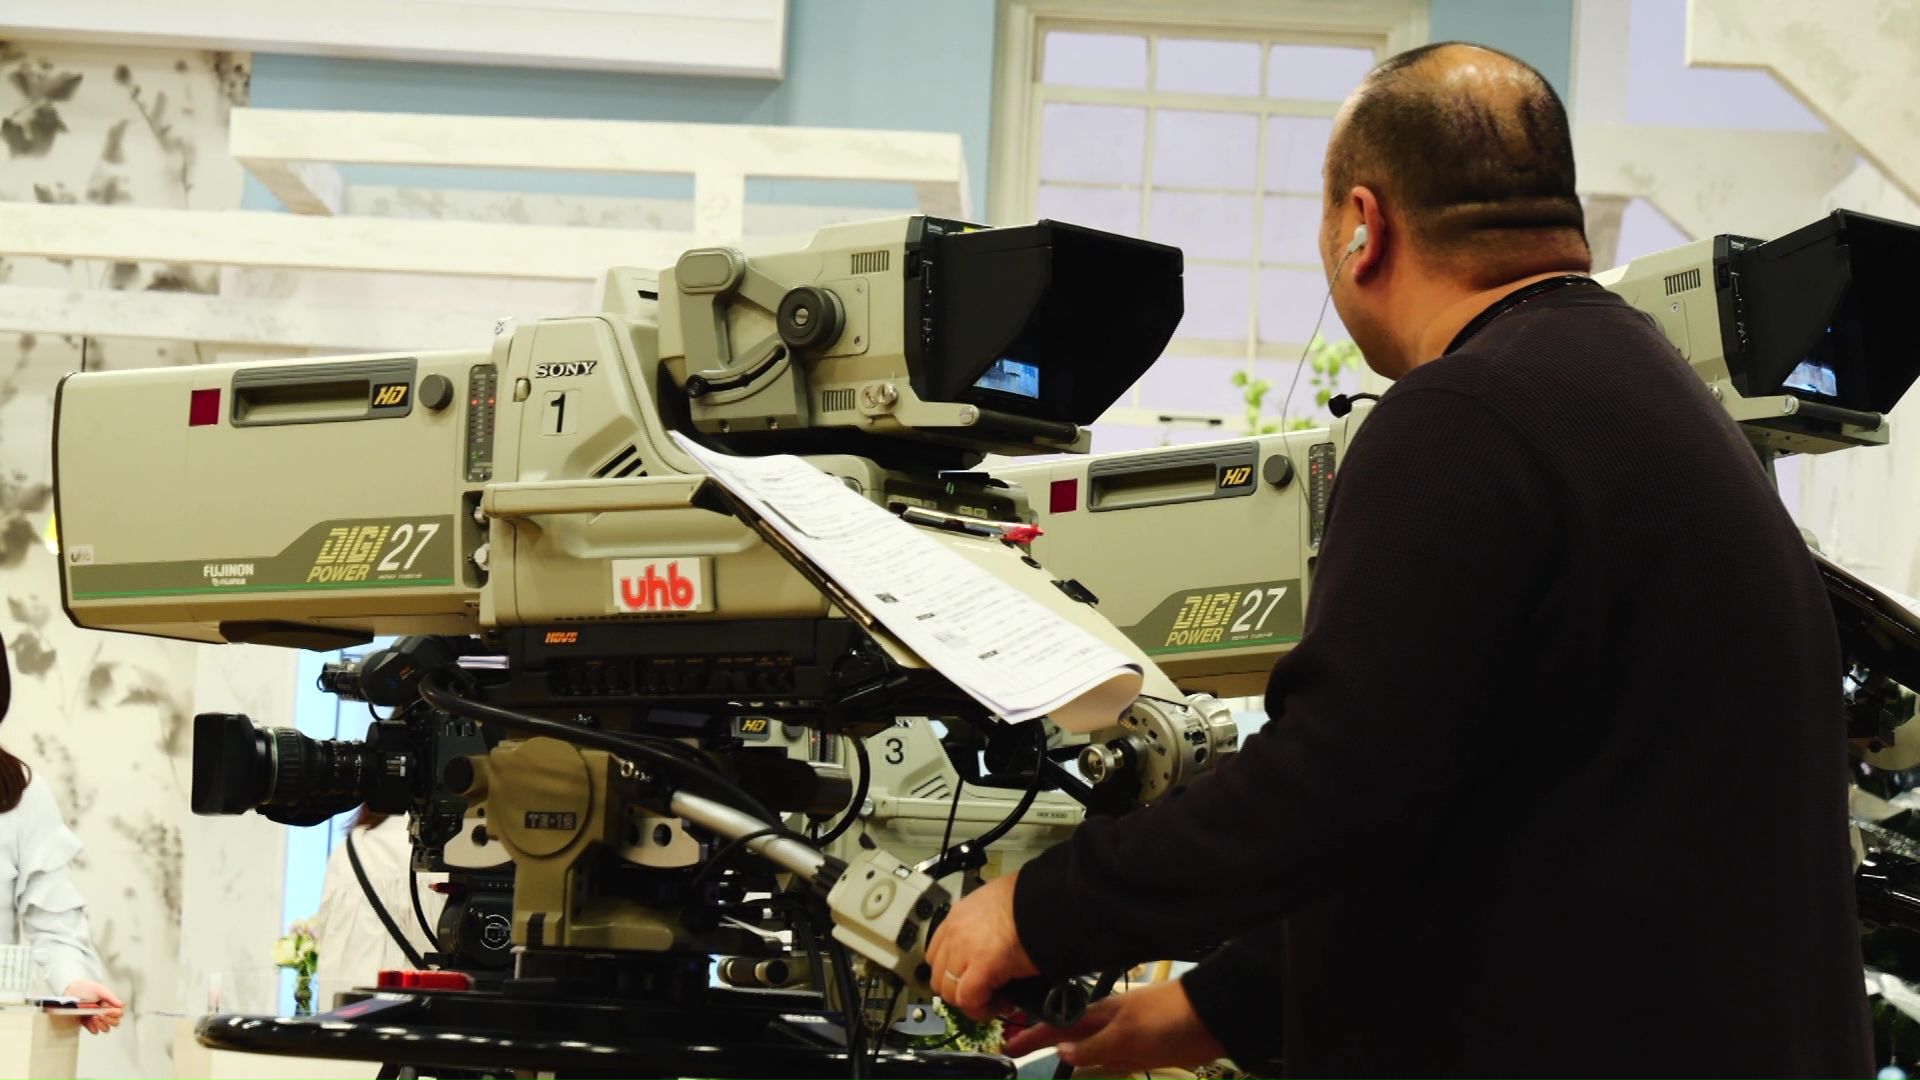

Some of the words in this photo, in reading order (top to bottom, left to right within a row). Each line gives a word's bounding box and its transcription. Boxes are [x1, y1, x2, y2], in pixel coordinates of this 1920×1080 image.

[535, 360, 598, 379] SONY
[373, 385, 408, 406] HD
[550, 391, 566, 434] 1
[1220, 466, 1252, 488] HD
[315, 525, 392, 565] DIGI
[376, 523, 440, 571] 27
[203, 563, 255, 577] FUJINON
[305, 563, 371, 582] POWER
[620, 561, 695, 610] uhb
[1172, 591, 1242, 630] DIGI
[1229, 586, 1287, 633] 27
[1164, 626, 1224, 647] POWER
[741, 719, 768, 732] HD
[885, 737, 904, 765] 3
